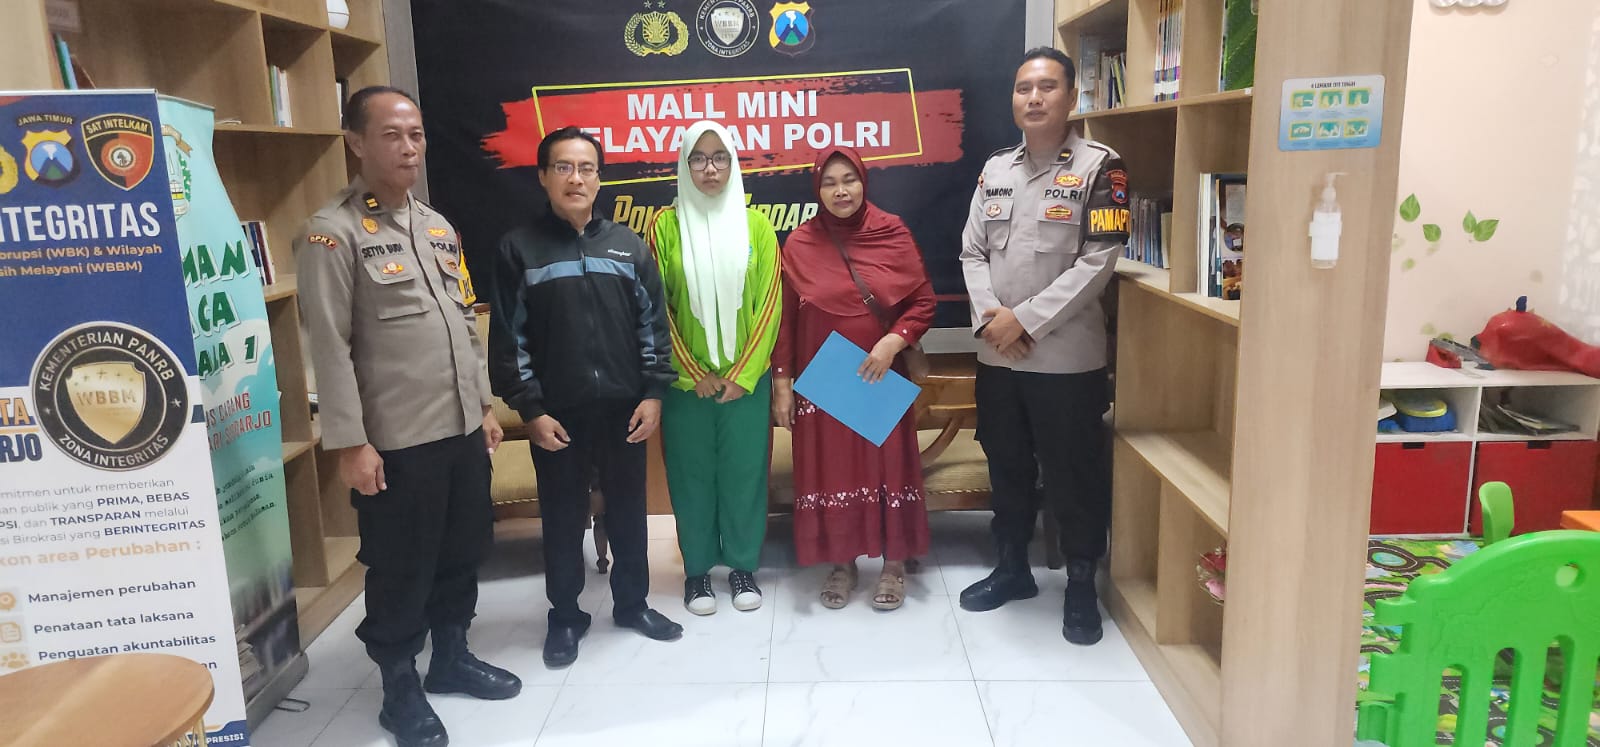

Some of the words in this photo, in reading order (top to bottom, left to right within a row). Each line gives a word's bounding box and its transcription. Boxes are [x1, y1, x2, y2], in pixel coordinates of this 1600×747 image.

[627, 93, 726, 121] MALL
[737, 90, 817, 119] MINI
[18, 115, 42, 126] JAWA
[44, 114, 73, 125] TIMUR
[86, 120, 103, 134] SAT
[104, 118, 148, 132] INTELKAM
[557, 124, 771, 152] LAYAAN
[784, 120, 891, 150] POLRI
[1044, 188, 1083, 201] POLRI
[46, 247, 90, 260] (WBK)
[93, 246, 103, 257] &
[106, 243, 163, 257] Wilayah
[361, 245, 386, 259] SETYO
[20, 263, 83, 277] Melayani
[86, 261, 143, 275] (WBBM)
[192, 291, 240, 335] CA
[244, 335, 257, 362] 1
[39, 331, 124, 392] KEMENTERIAN
[128, 335, 175, 381] PANRB
[76, 388, 137, 406] WBBM
[59, 433, 91, 462] ZONA
[94, 433, 169, 467] INTEGRITAS
[53, 484, 92, 496] untuk
[95, 479, 175, 492] memberikan
[20, 502, 60, 515] publik
[61, 501, 94, 513] yang
[96, 495, 144, 507] PRIMA,
[146, 491, 190, 503] BEBAS
[24, 519, 48, 529] dan
[49, 510, 141, 526] TRANSPARAN
[144, 507, 189, 518] melalui
[13, 532, 67, 545] Birokrasi
[70, 530, 101, 542] yang
[104, 519, 206, 536] BERINTEGRITAS
[37, 551, 80, 564] area
[85, 540, 191, 559] Perubahan
[28, 588, 114, 603] Manajemen
[118, 579, 197, 597] perubahan
[33, 620, 103, 634] Penataan
[107, 616, 137, 628] tata
[139, 611, 195, 625] laksana
[38, 644, 119, 660] Penguatan
[122, 634, 216, 652] akuntabilitas
